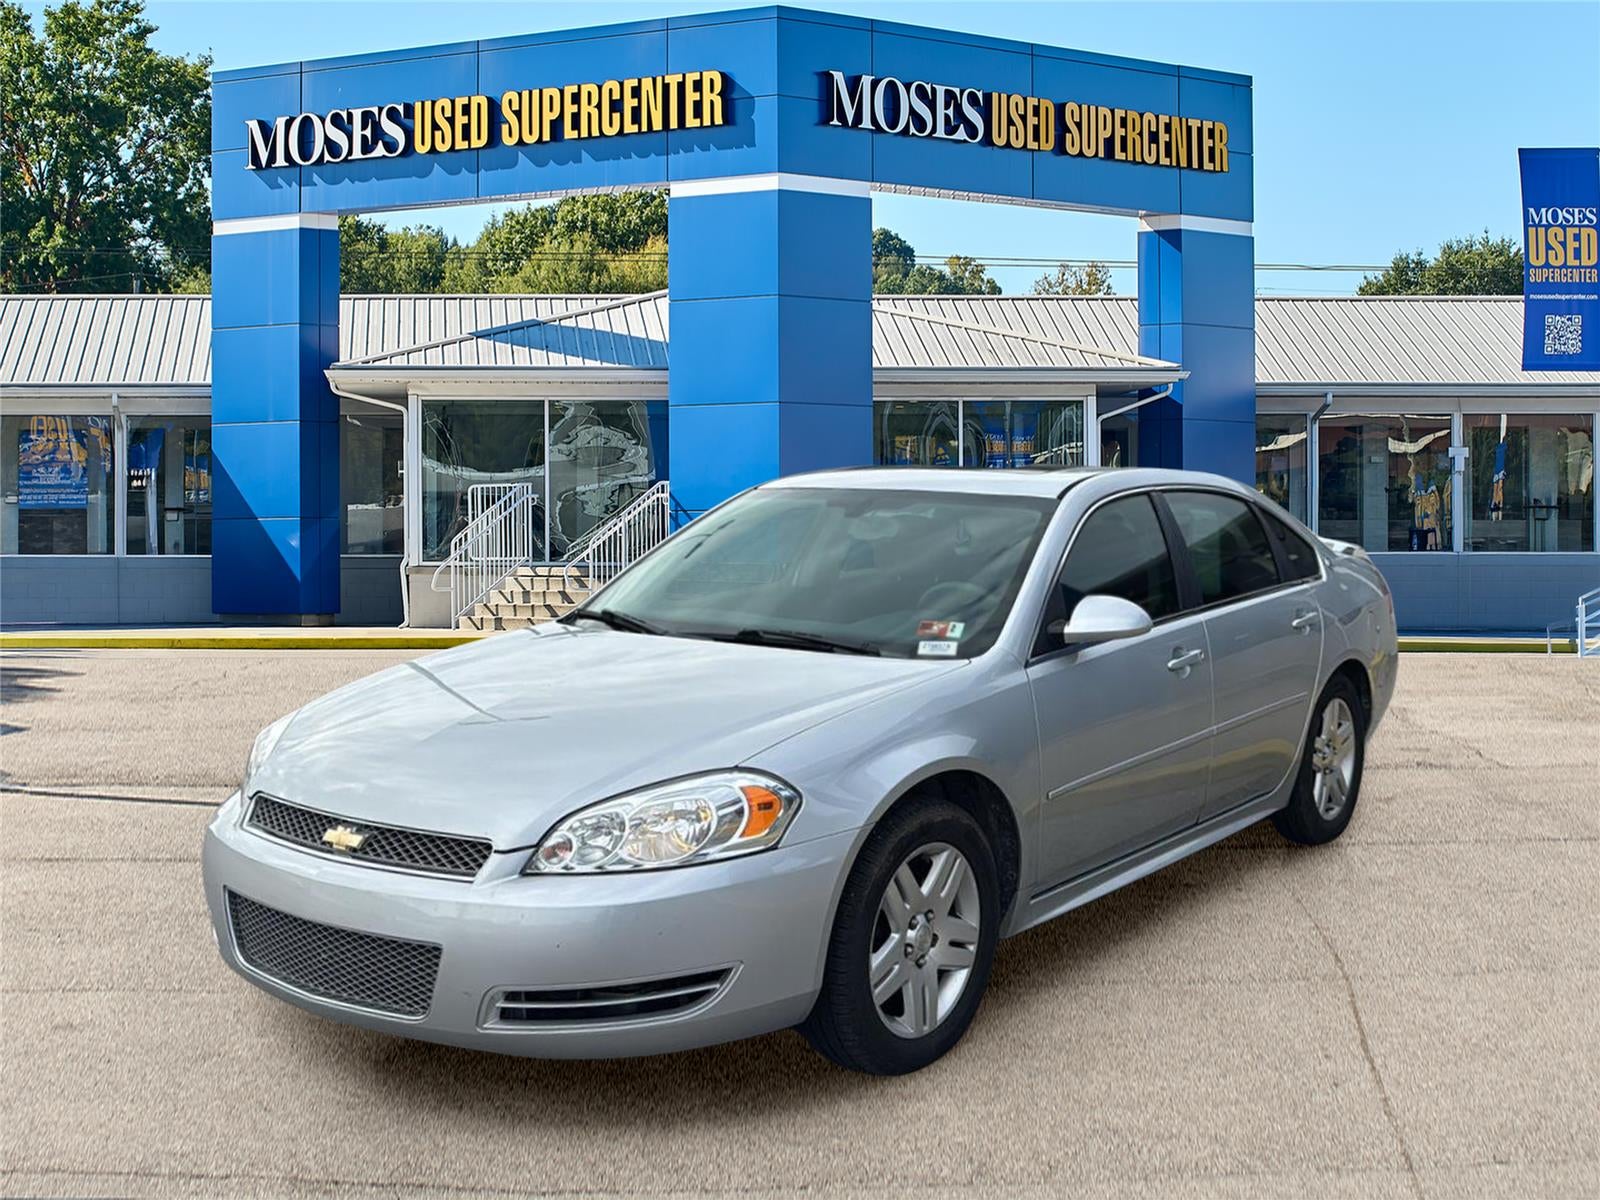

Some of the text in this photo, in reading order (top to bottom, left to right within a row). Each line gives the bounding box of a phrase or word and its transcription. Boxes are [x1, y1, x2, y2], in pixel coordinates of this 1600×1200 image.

[245, 70, 723, 170] MOSES USED SUPERCENTER
[829, 70, 1229, 173] MOSES USED SUPERCENTER
[1528, 207, 1597, 225] MOSES
[1528, 227, 1598, 267] USED
[1529, 268, 1598, 283] SUPERCENTER
[1529, 293, 1599, 301] mosesusedsupercenter.com
